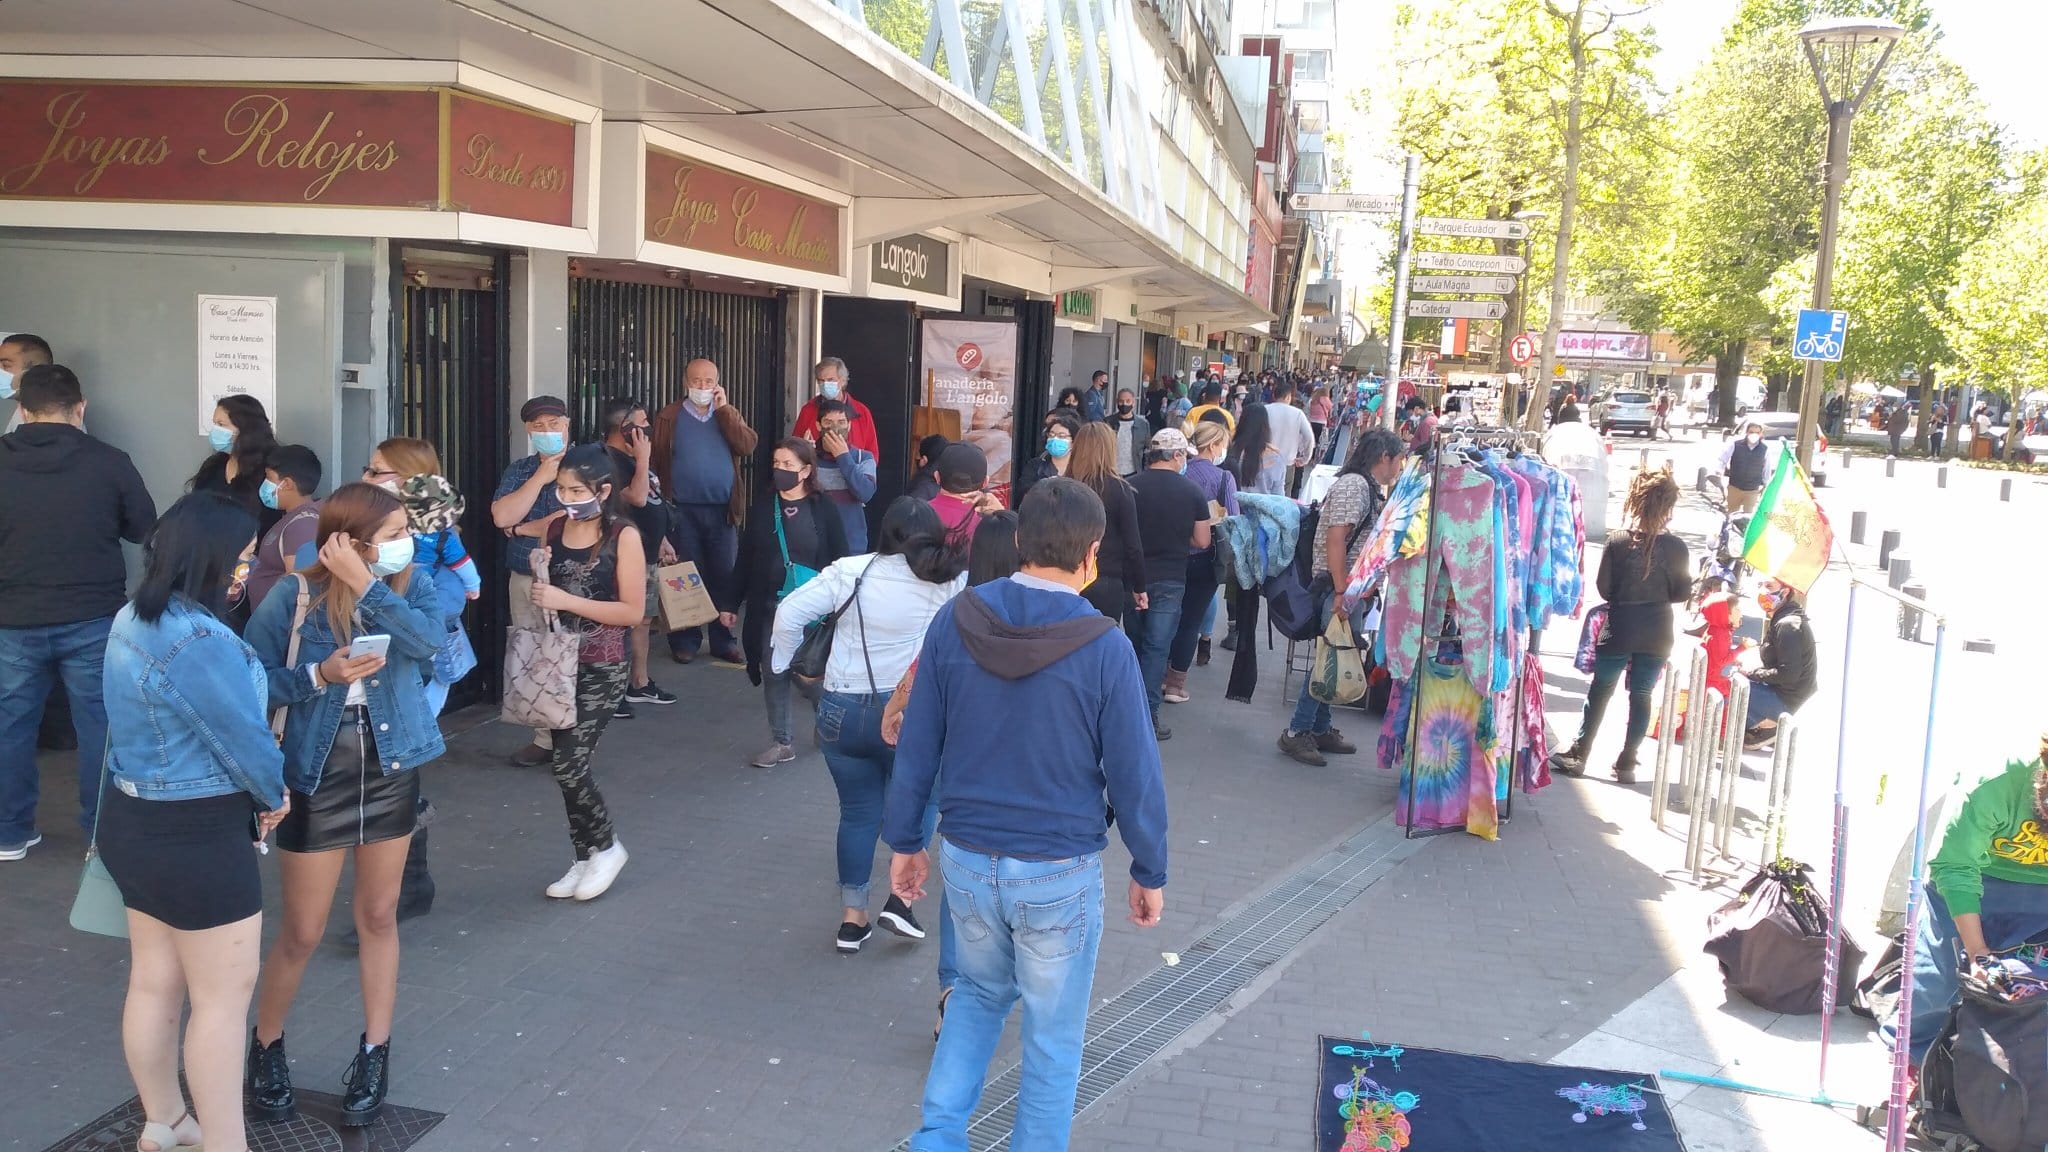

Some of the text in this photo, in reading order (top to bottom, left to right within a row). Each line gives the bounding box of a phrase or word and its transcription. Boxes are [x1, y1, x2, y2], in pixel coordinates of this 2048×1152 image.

[1, 90, 399, 200] Joyas Relojes
[460, 133, 523, 186] Desde
[654, 166, 719, 244] Joyas
[731, 187, 772, 251] Casa
[1346, 198, 1382, 209] Mercado
[1433, 221, 1497, 234] Parque Ecuador
[880, 240, 927, 286] Langolo
[1431, 256, 1455, 266] Teatro
[1425, 279, 1471, 291] Aula Magna
[1420, 304, 1451, 314] Catedral
[1830, 313, 1845, 332] E
[210, 333, 230, 342] Horario
[237, 353, 258, 361] Viernes
[212, 361, 228, 369] 10:00
[933, 376, 994, 390] anadería
[946, 389, 1008, 407] L'angolo
